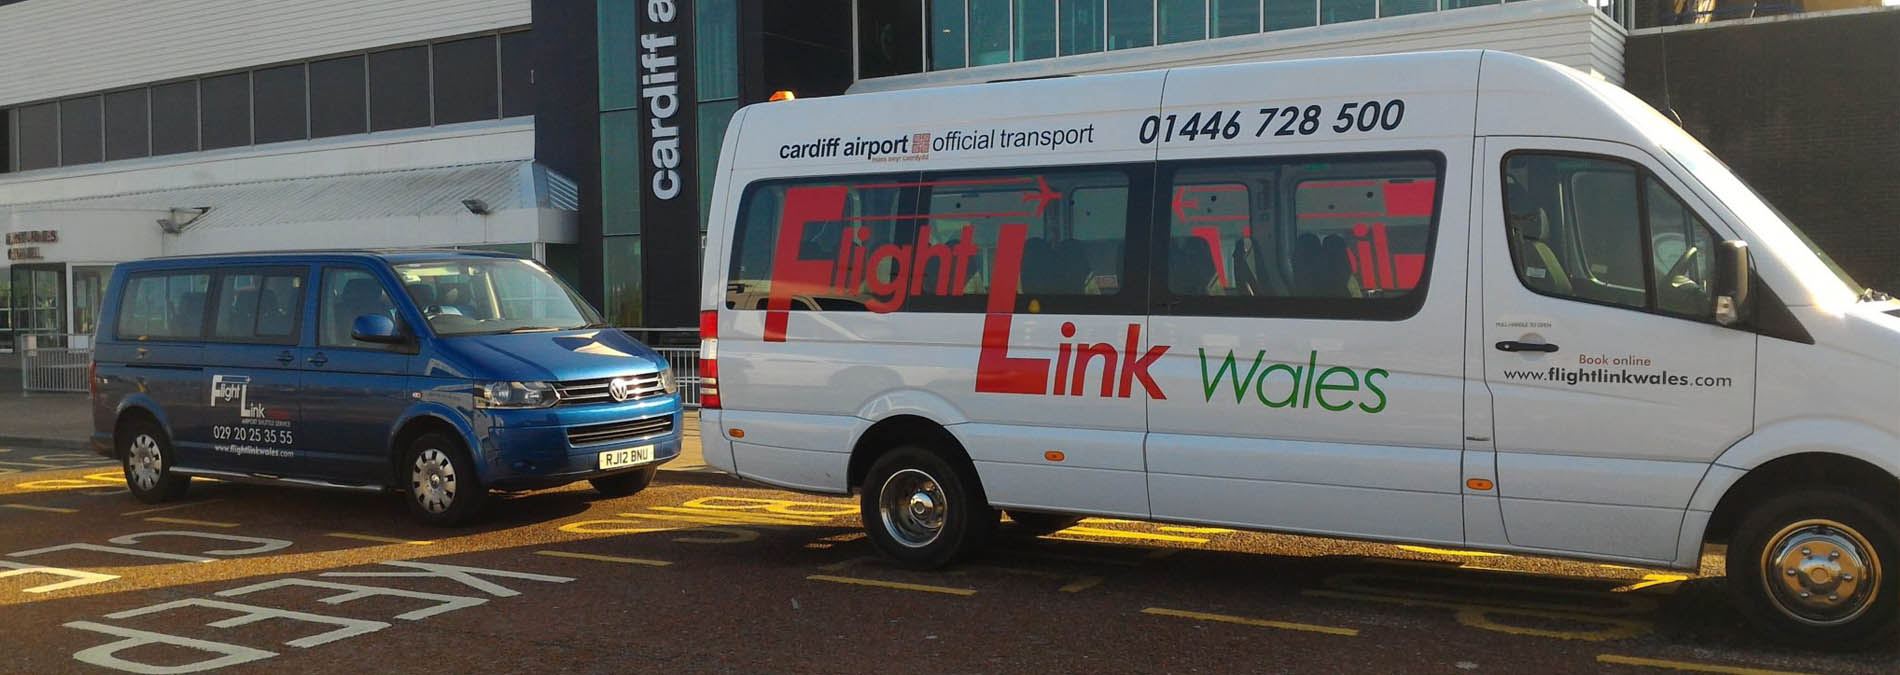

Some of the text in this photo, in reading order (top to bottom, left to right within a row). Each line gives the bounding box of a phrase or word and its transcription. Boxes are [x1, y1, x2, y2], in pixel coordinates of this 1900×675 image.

[640, 33, 681, 200] cardiff
[1139, 99, 1405, 144] 01446 728 500
[779, 123, 1095, 160] cardiff airport official transport
[763, 185, 980, 342] Flight
[974, 222, 1172, 400] Link
[1198, 347, 1389, 414] Wales
[1504, 366, 1733, 388] www.flightlinkwales.com
[1579, 354, 1652, 367] Book online
[240, 384, 265, 418] Link
[213, 425, 293, 445] 029 20 25 35 55
[214, 443, 294, 457] www.flightlinkwales.com
[606, 448, 648, 466] RJ12 BNU
[62, 560, 577, 675] KEEP
